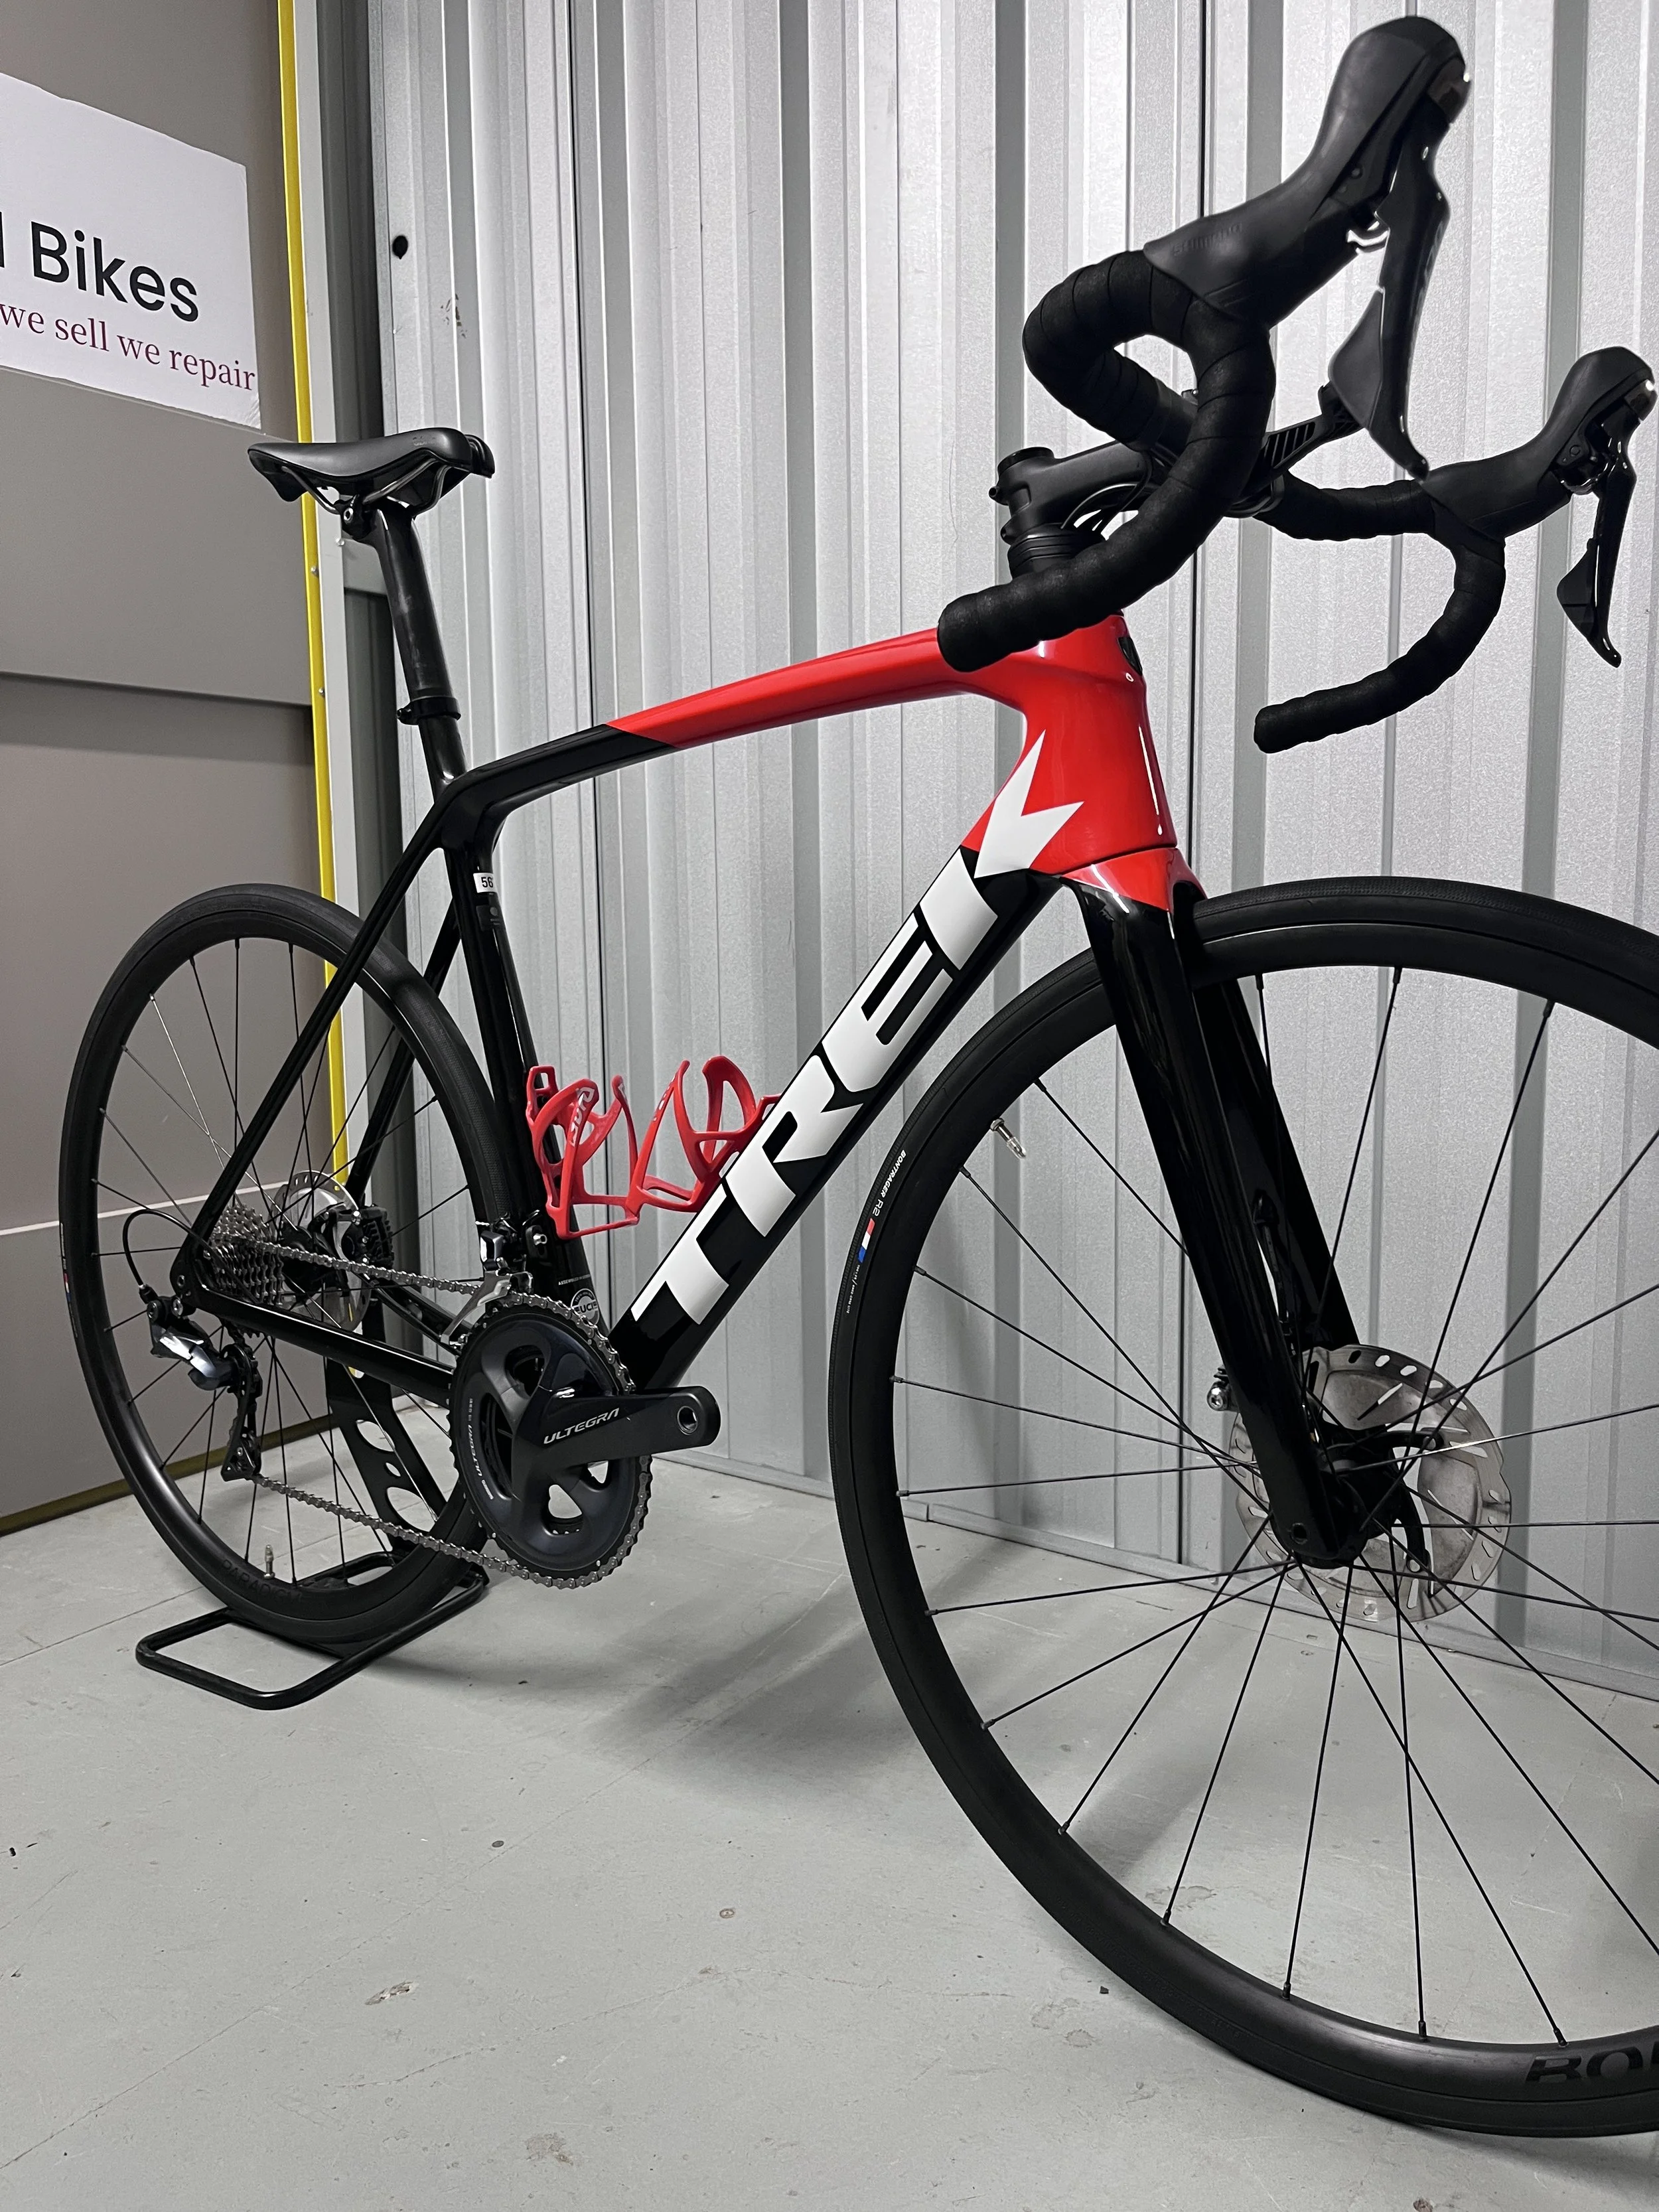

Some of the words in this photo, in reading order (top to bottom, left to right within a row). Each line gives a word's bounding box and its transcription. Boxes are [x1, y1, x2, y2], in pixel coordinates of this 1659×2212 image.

[31, 221, 198, 322] Bikes
[0, 303, 44, 334] we
[55, 318, 110, 352] sell
[117, 334, 161, 365] we
[170, 348, 256, 390] repair
[630, 729, 1084, 1325] TREK
[881, 1149, 906, 1198] BONTRAGER
[873, 1199, 884, 1217] R2
[543, 1407, 620, 1444] ULTEGRA
